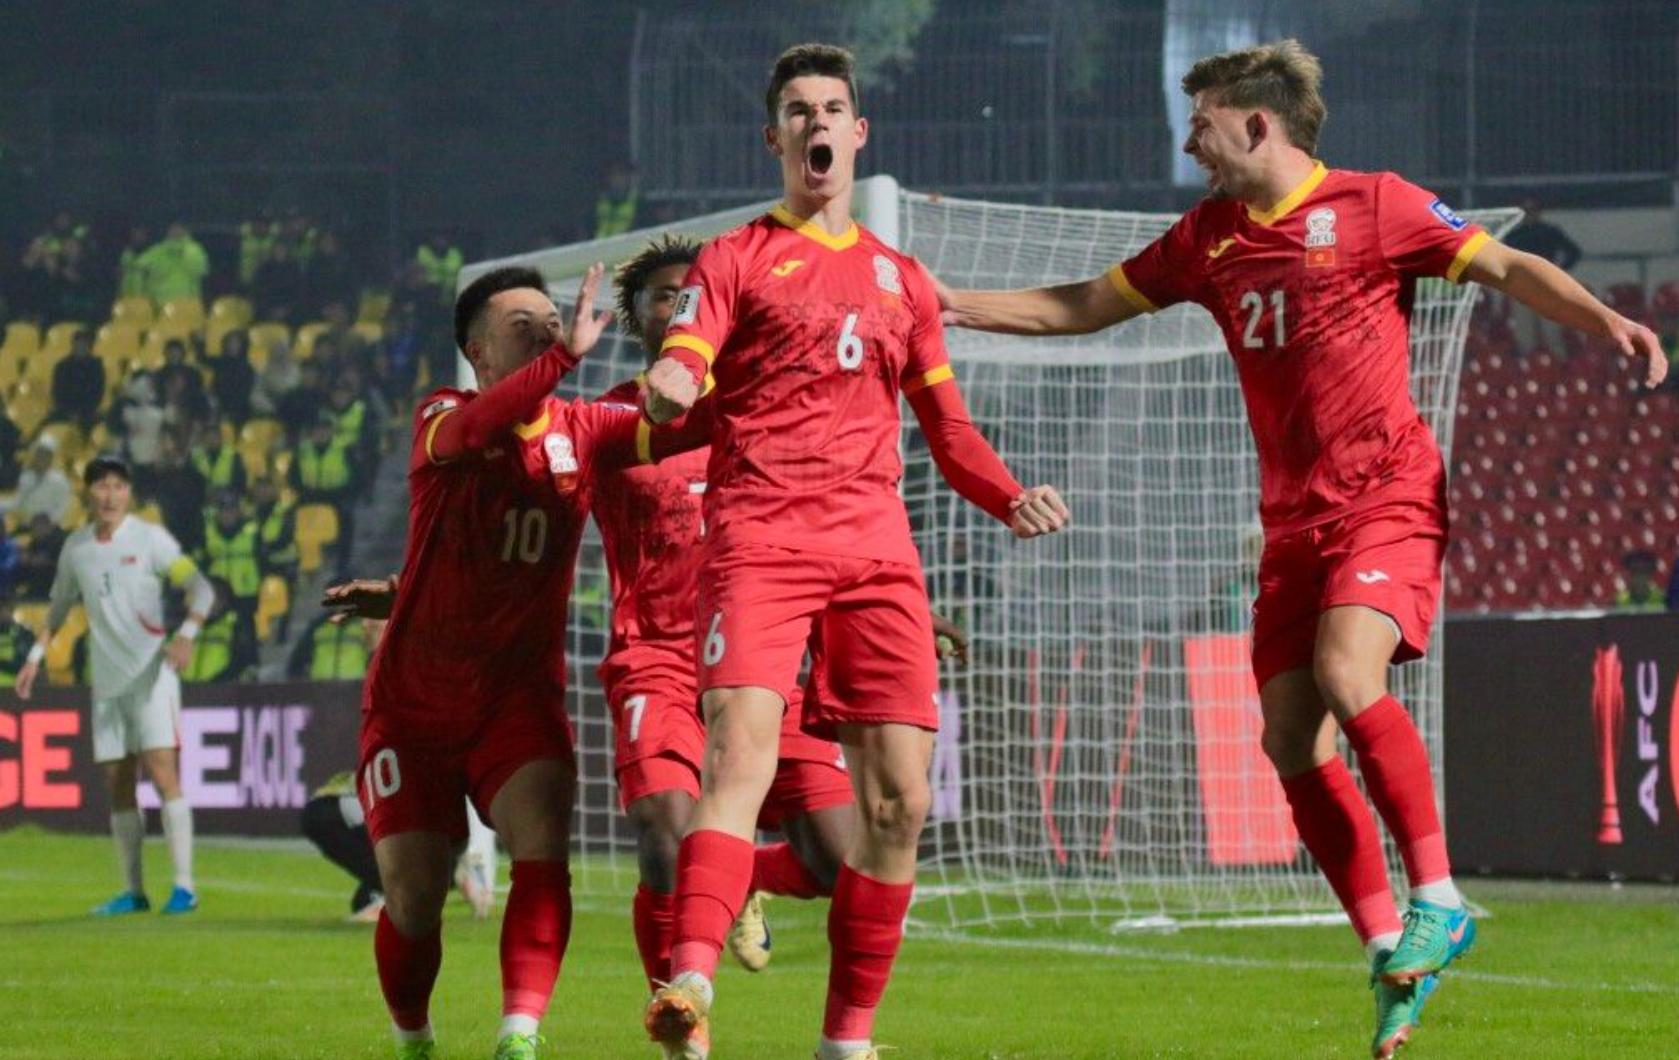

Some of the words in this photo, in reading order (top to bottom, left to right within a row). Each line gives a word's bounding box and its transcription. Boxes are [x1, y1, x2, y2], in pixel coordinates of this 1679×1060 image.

[838, 314, 863, 369] 6
[1240, 290, 1286, 349] 21
[502, 509, 548, 563] 10
[703, 611, 726, 666] 6
[623, 694, 647, 743] 7
[1638, 662, 1659, 824] AFC
